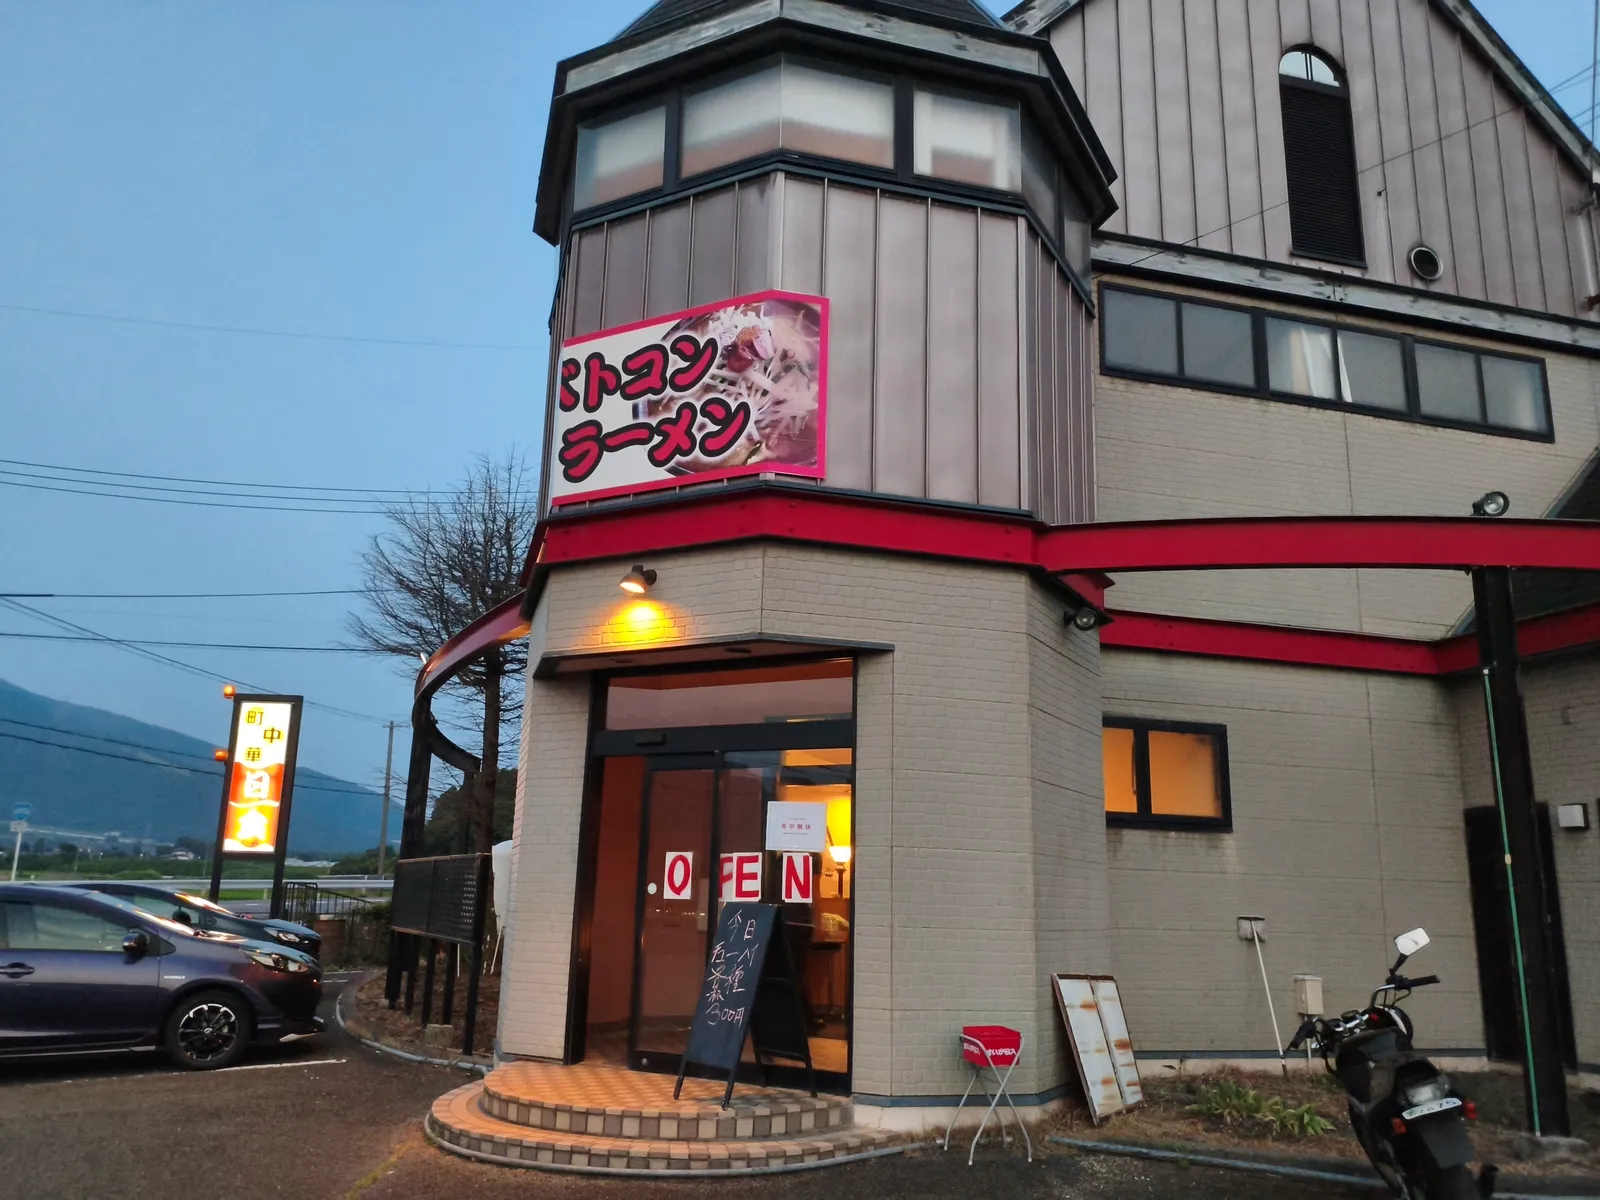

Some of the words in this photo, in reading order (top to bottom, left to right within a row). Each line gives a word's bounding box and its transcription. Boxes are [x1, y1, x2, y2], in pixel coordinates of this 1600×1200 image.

[558, 397, 751, 483] ラーメン
[246, 710, 281, 762] 町中華
[667, 854, 811, 900] OPEN
[727, 908, 756, 941] 今日
[705, 1002, 745, 1028] 300円
